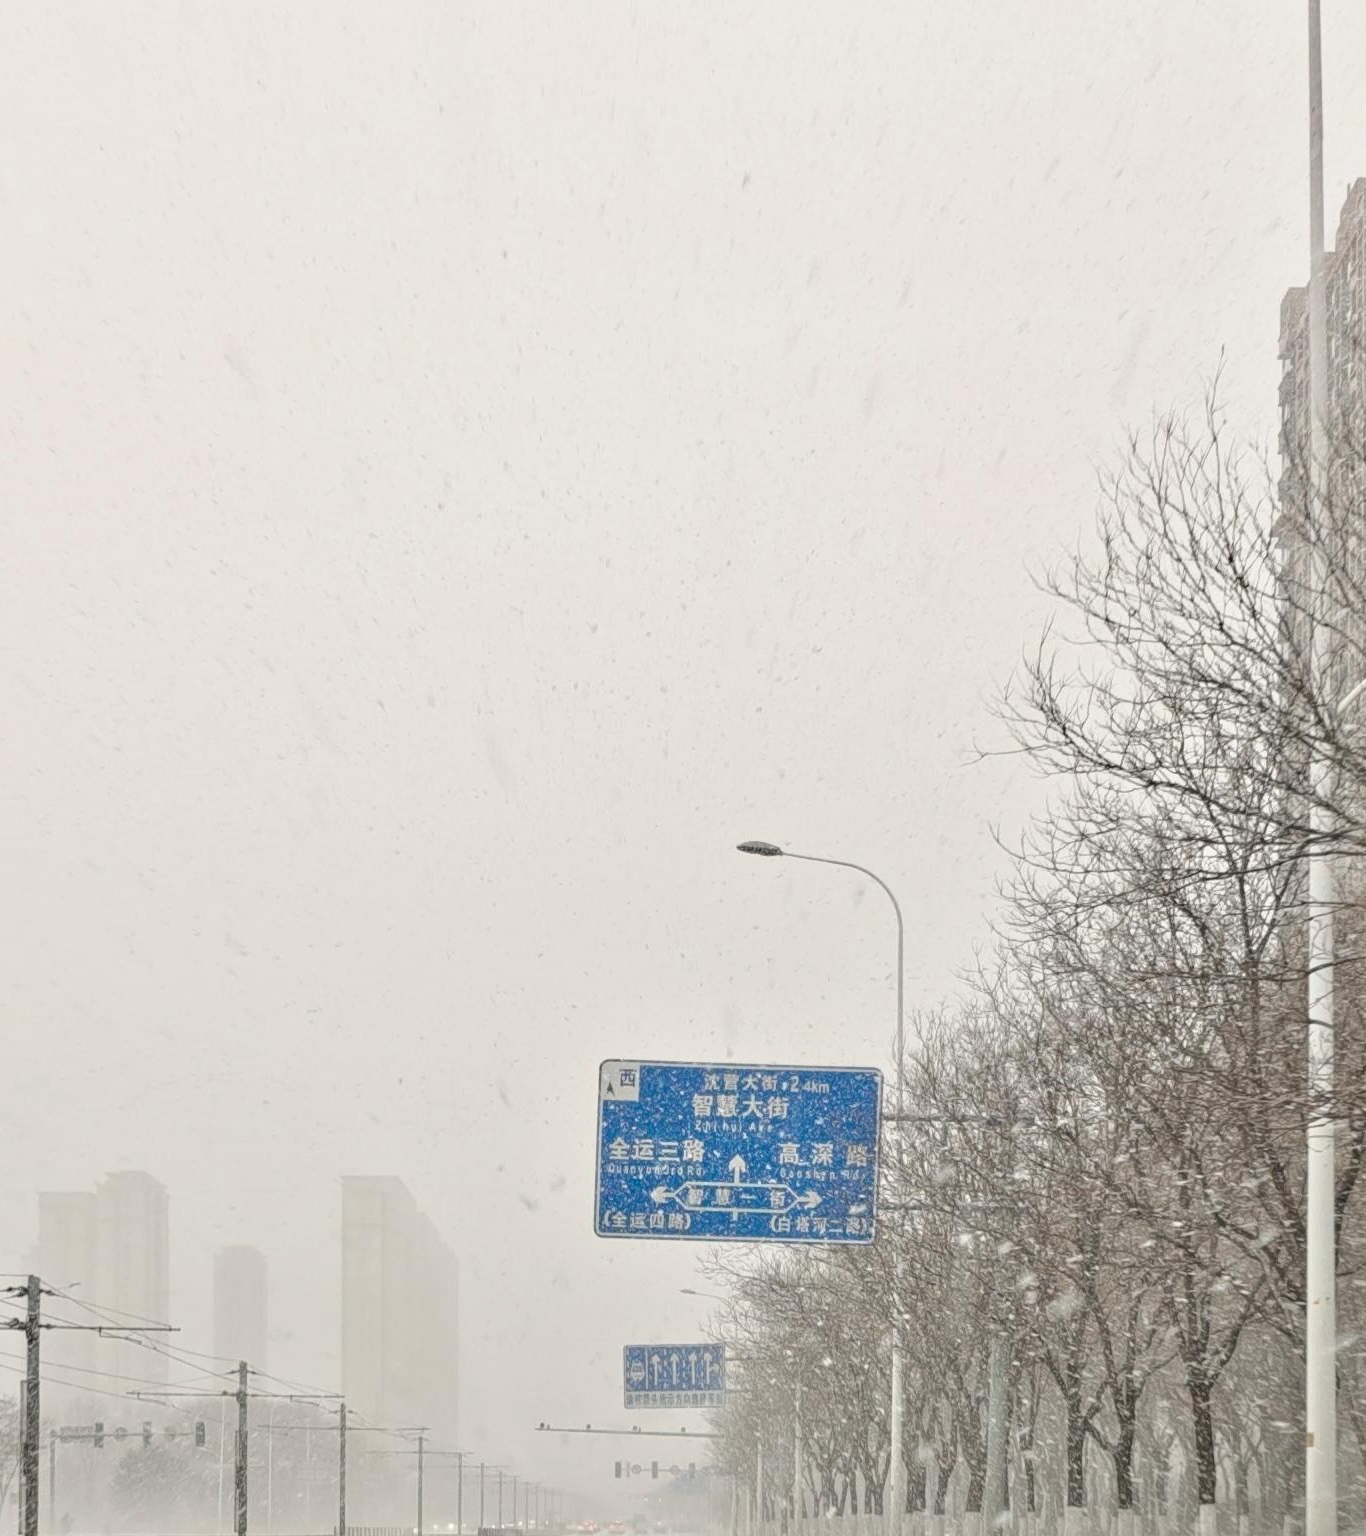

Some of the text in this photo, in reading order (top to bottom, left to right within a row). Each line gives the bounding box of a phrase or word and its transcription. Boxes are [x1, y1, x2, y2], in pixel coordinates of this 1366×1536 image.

[619, 1068, 637, 1088] 西
[692, 1094, 789, 1119] 智慧大街
[609, 1137, 705, 1163] 全运三路
[779, 1142, 869, 1167] 高深路
[686, 1187, 787, 1209] 智慧一街
